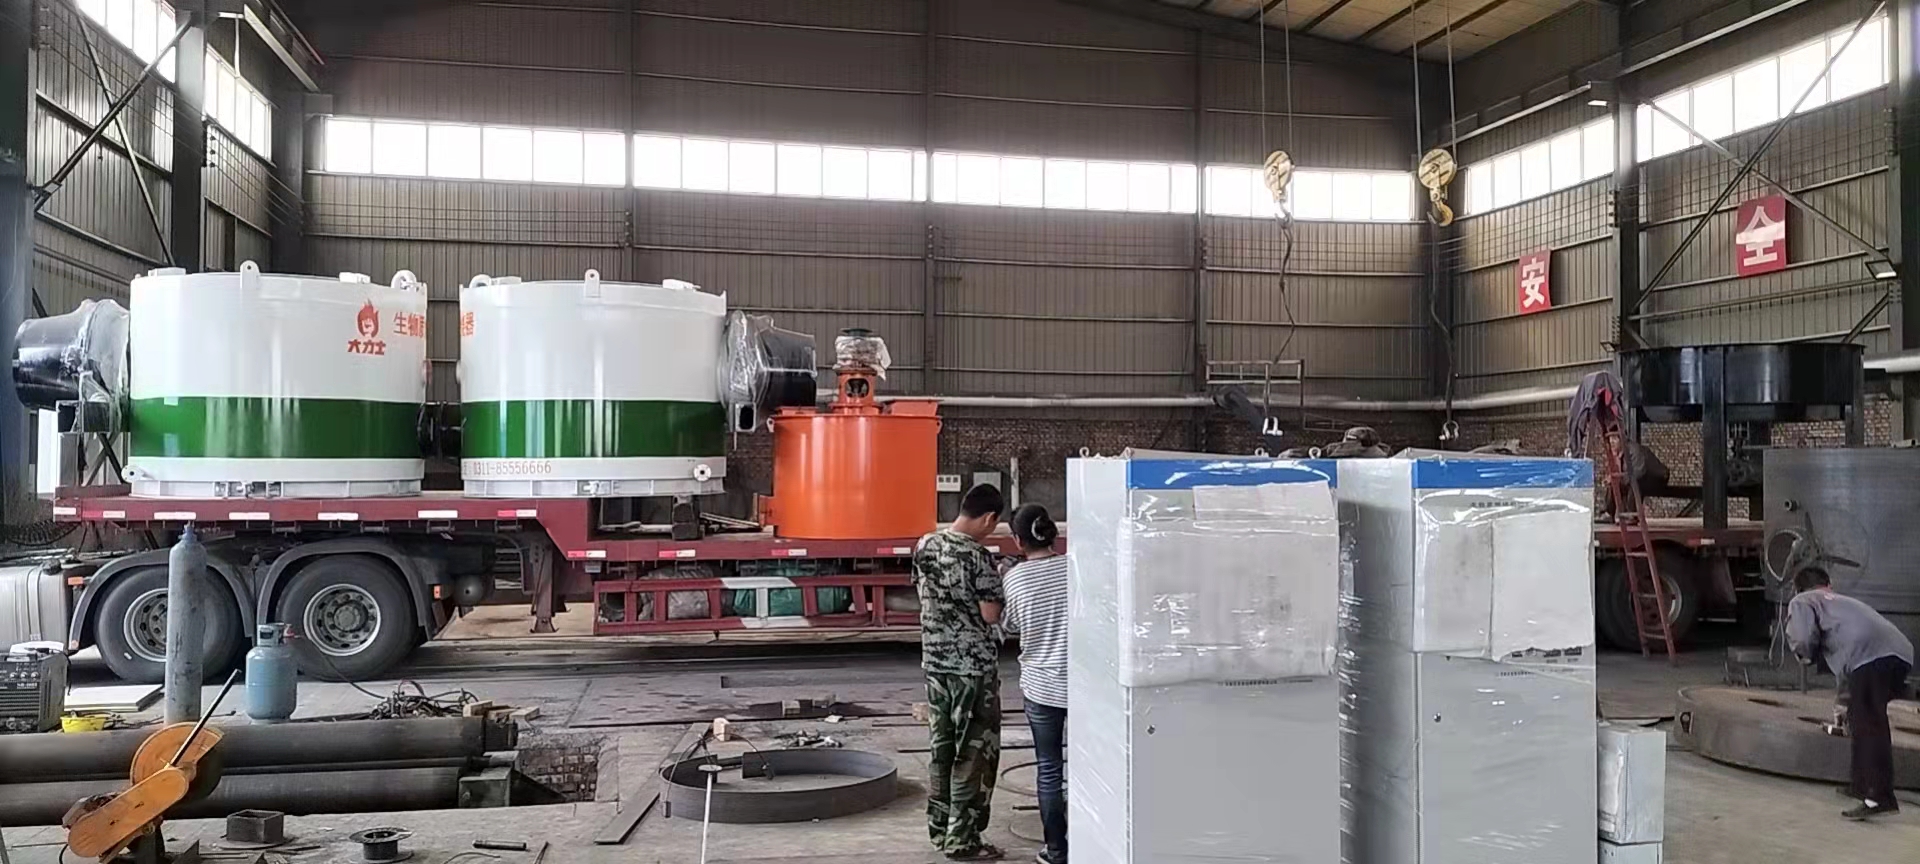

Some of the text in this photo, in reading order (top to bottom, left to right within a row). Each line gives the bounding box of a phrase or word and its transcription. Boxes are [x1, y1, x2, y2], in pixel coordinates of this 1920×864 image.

[1741, 204, 1779, 267] 全
[1521, 257, 1546, 309] 安
[347, 338, 387, 355] 大力士
[473, 460, 552, 476] 0311-85556666
